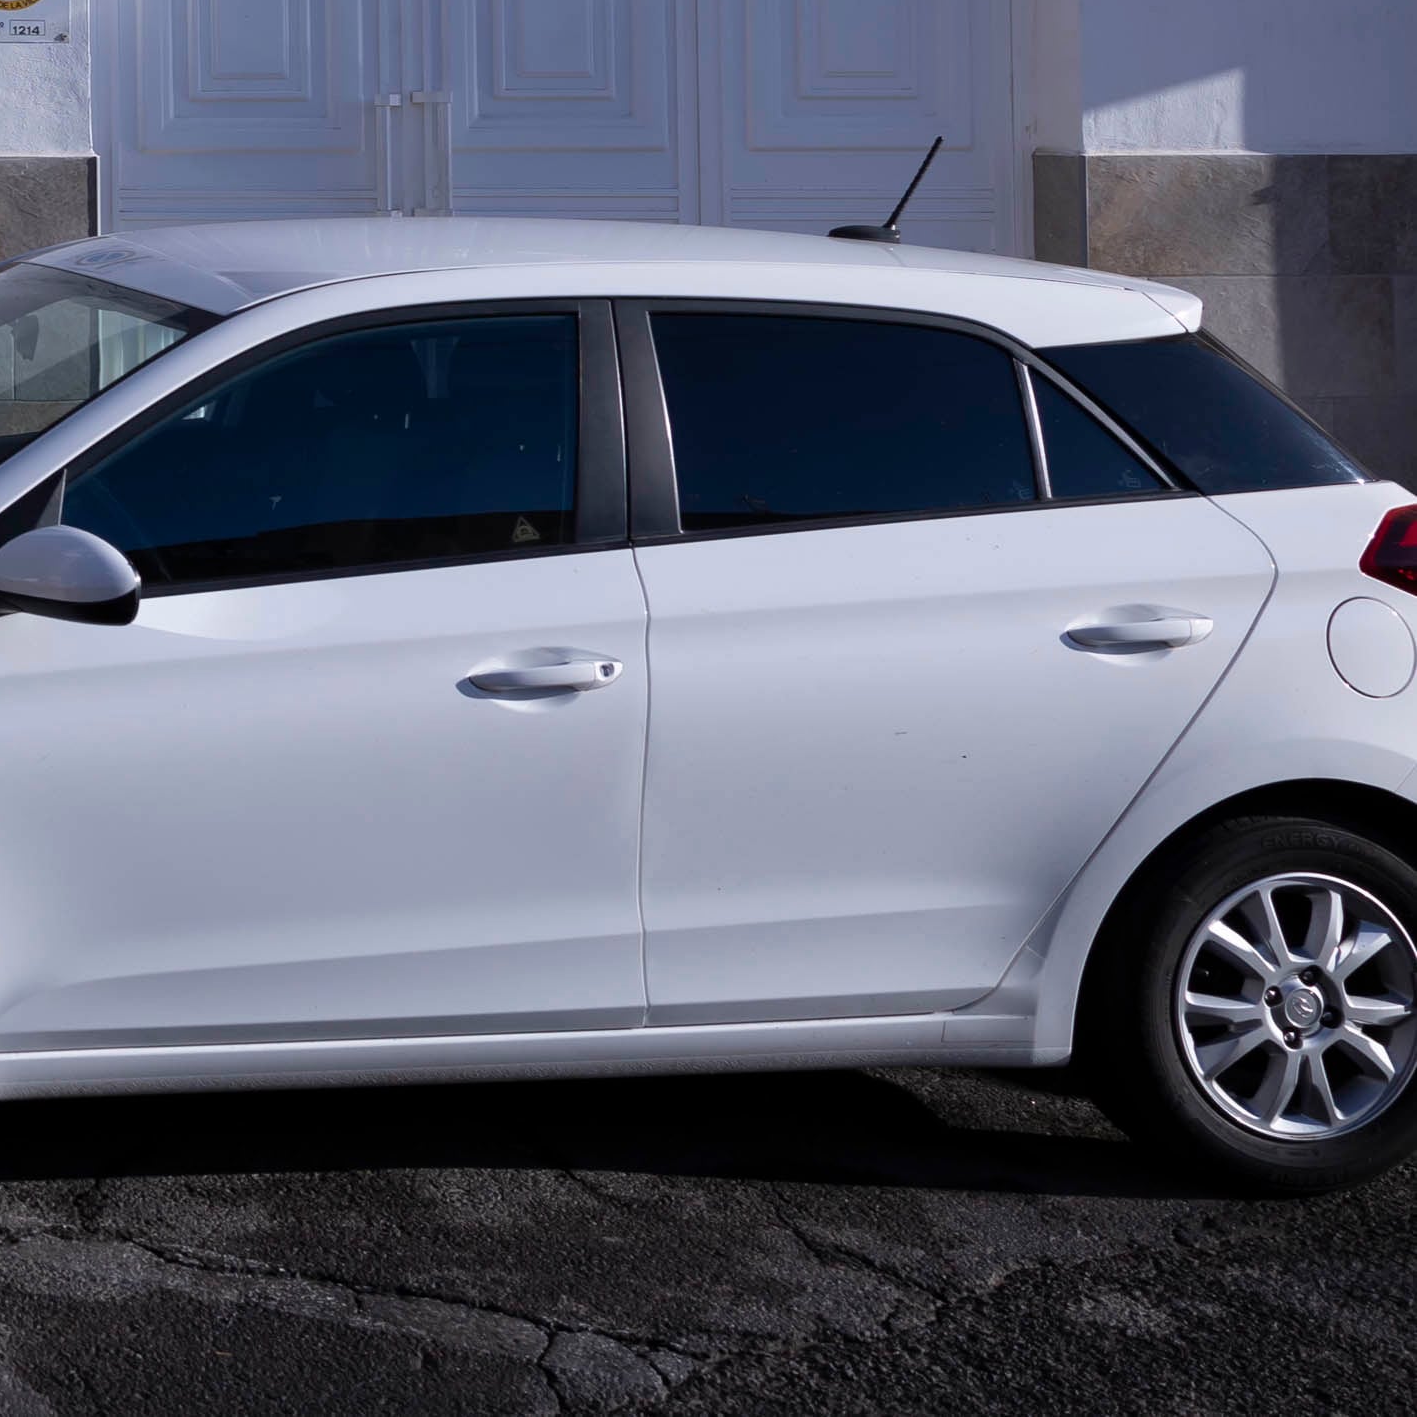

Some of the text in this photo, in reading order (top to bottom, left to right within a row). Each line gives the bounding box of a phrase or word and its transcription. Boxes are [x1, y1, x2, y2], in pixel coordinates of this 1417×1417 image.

[11, 0, 22, 9] LA
[12, 25, 40, 35] 1214
[1260, 830, 1340, 849] ENERGY
